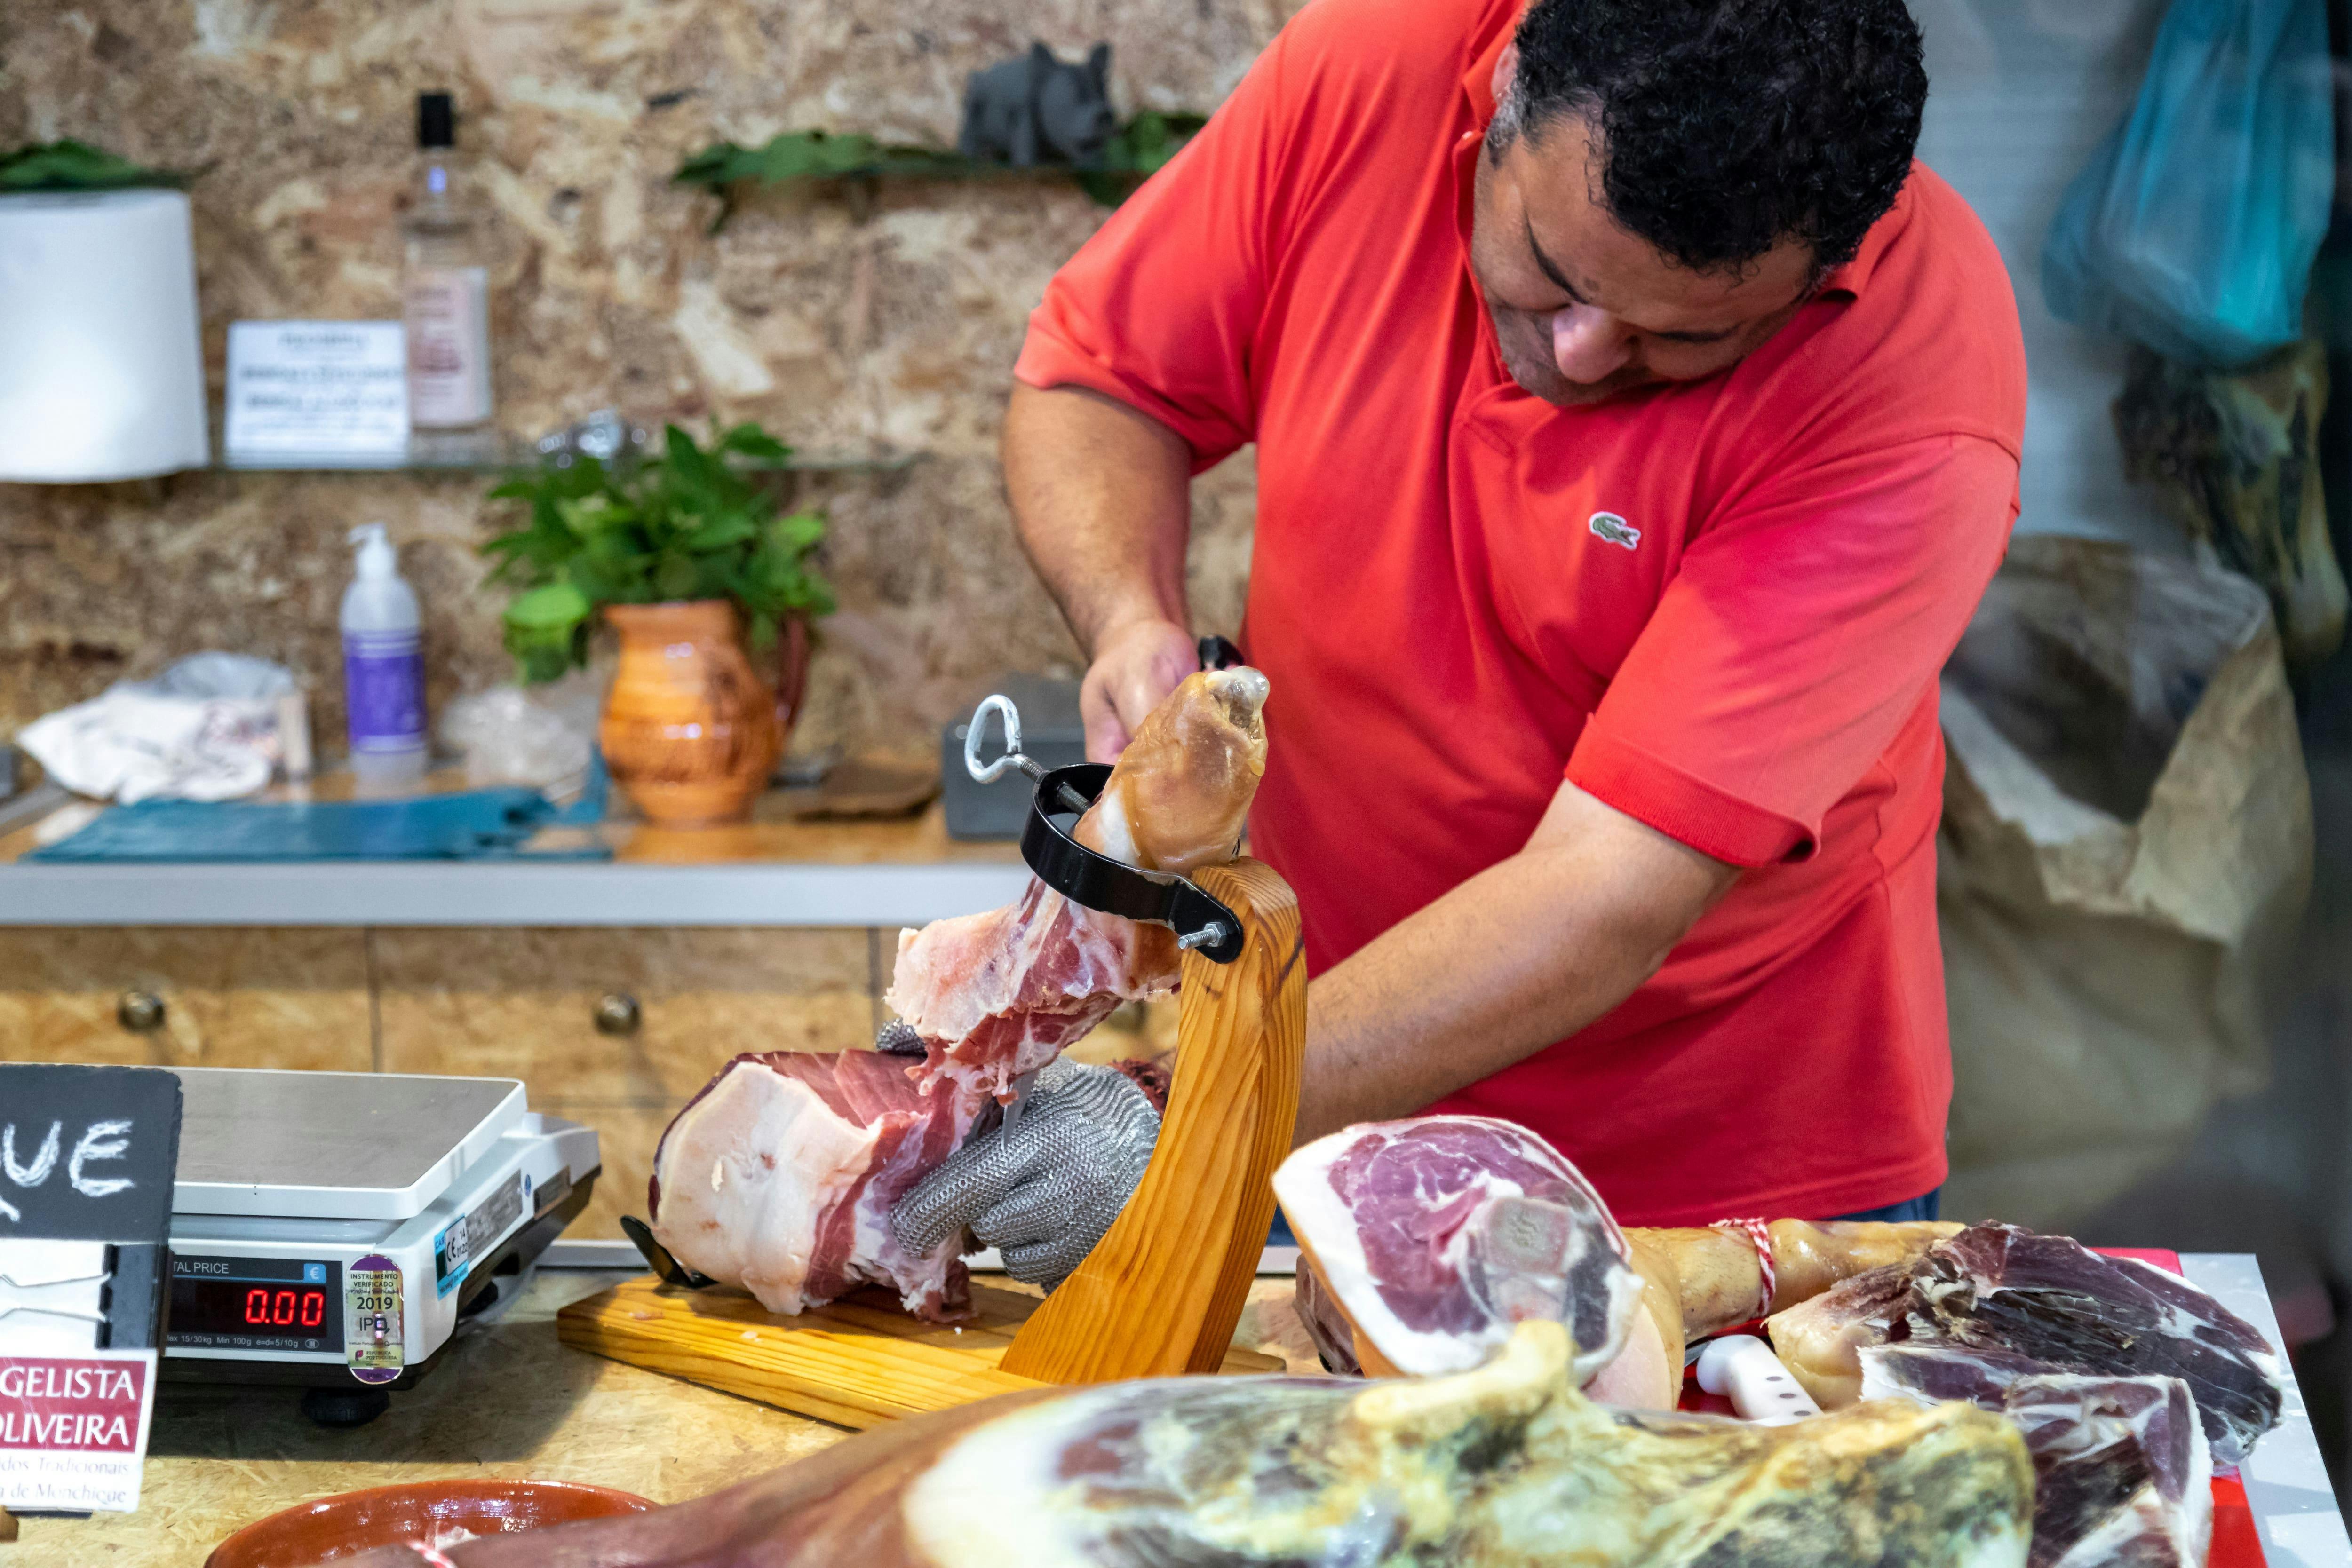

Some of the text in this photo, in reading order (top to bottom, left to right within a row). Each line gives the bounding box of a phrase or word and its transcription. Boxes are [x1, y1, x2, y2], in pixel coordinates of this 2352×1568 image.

[0, 1119, 135, 1222] UE
[194, 1262, 229, 1274] PRICE
[310, 1267, 319, 1280] €
[245, 1289, 324, 1326] 0.00
[357, 1297, 393, 1310] 2019
[359, 1317, 390, 1334] IPQ
[181, 1335, 212, 1345] 15/30kg
[234, 1338, 251, 1346] 100g
[0, 1366, 135, 1400] GELISTA
[0, 1412, 129, 1446] LIVEIRA
[39, 1457, 129, 1475] Tradicionais
[11, 1483, 29, 1499] de
[36, 1484, 127, 1505] Monchique
